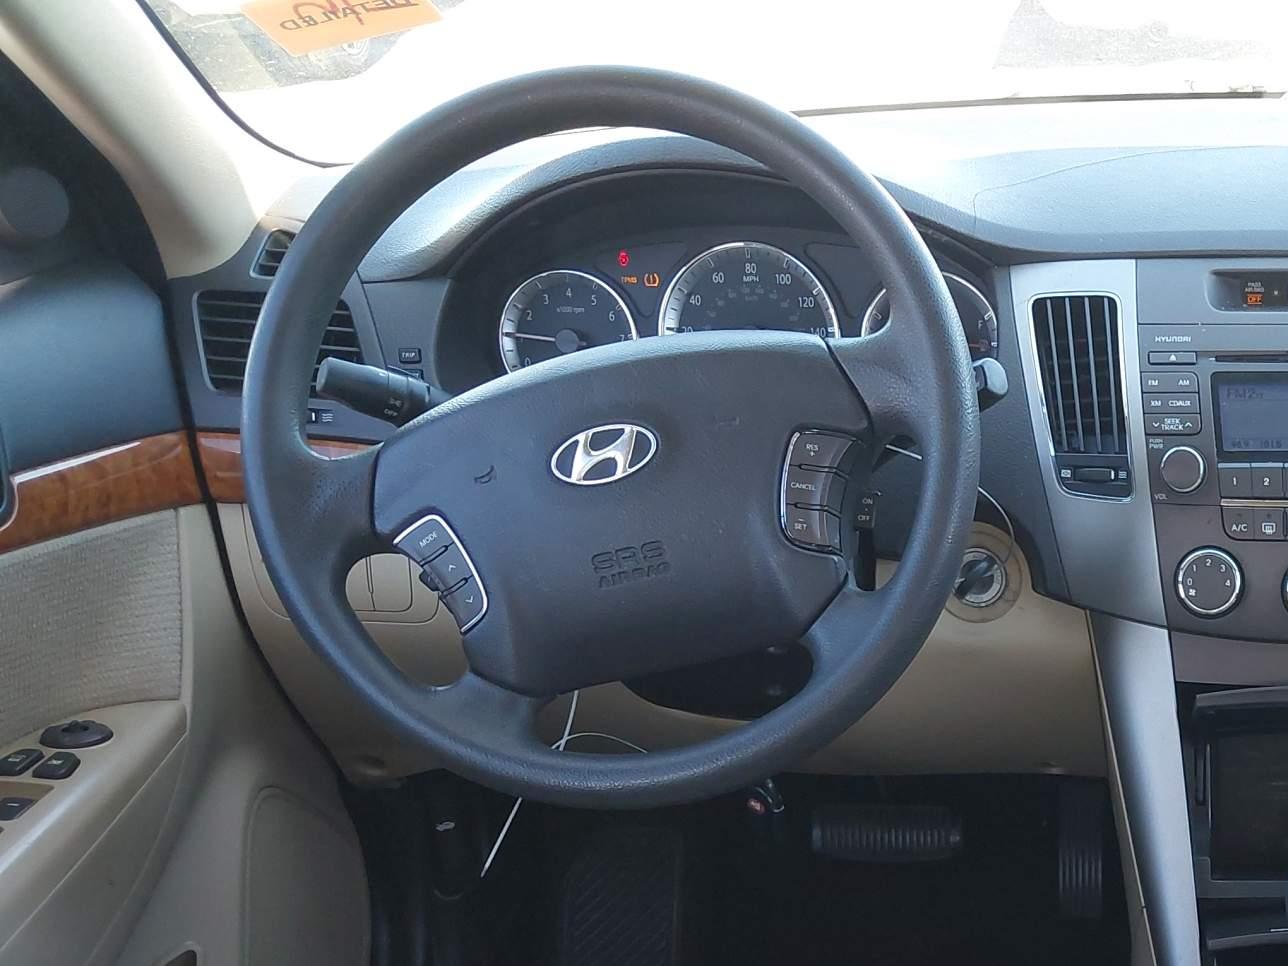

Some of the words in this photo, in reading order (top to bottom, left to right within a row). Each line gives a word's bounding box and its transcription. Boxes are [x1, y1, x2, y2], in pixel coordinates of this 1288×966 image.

[745, 263, 757, 274] 80
[712, 273, 724, 283] 60
[776, 274, 791, 285] 100
[566, 288, 572, 298] 4
[543, 294, 549, 304] 3
[592, 295, 597, 305] 5
[690, 295, 701, 305] 40
[799, 297, 814, 307] 120
[527, 310, 533, 320] 2
[609, 311, 615, 321] 6
[791, 482, 816, 491] CANCEL
[1233, 477, 1237, 486] 1
[1263, 478, 1270, 486] 2
[1231, 523, 1248, 532] A/C
[419, 531, 438, 548] MODE
[592, 540, 667, 574] SRS
[1206, 559, 1212, 567] 2
[1220, 564, 1226, 572] 3
[1187, 578, 1193, 586] 0
[1225, 579, 1231, 587] 4
